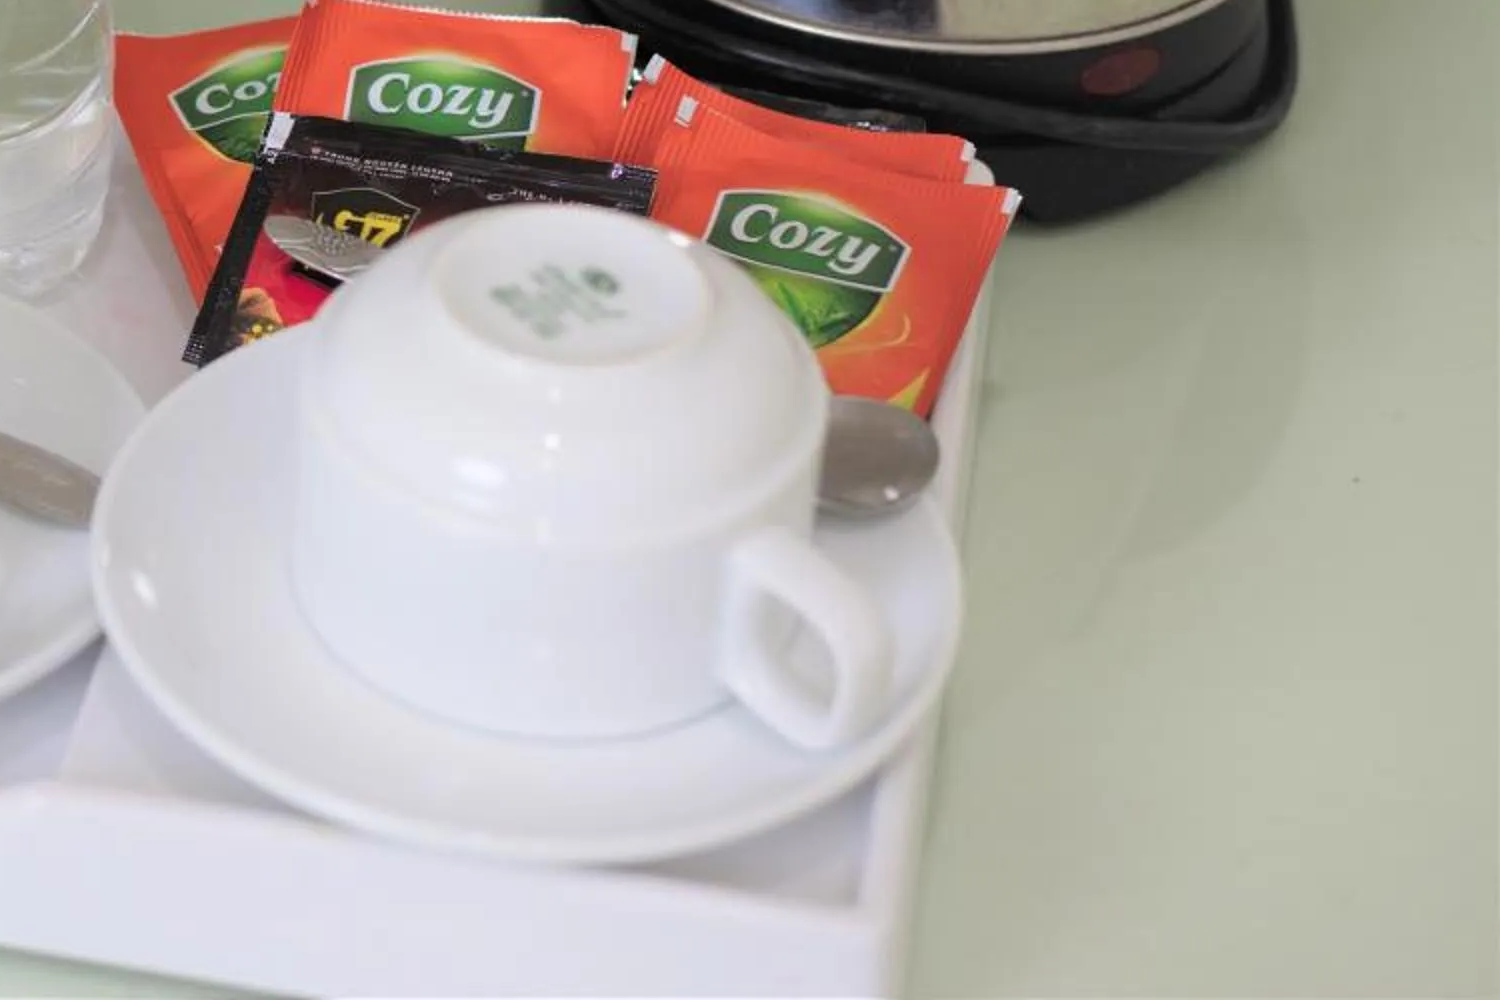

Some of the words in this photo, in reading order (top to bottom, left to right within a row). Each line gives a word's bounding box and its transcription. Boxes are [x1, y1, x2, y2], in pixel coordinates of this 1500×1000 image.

[195, 71, 282, 115] Co
[367, 72, 515, 129] Cozy
[730, 203, 882, 275] Cozy
